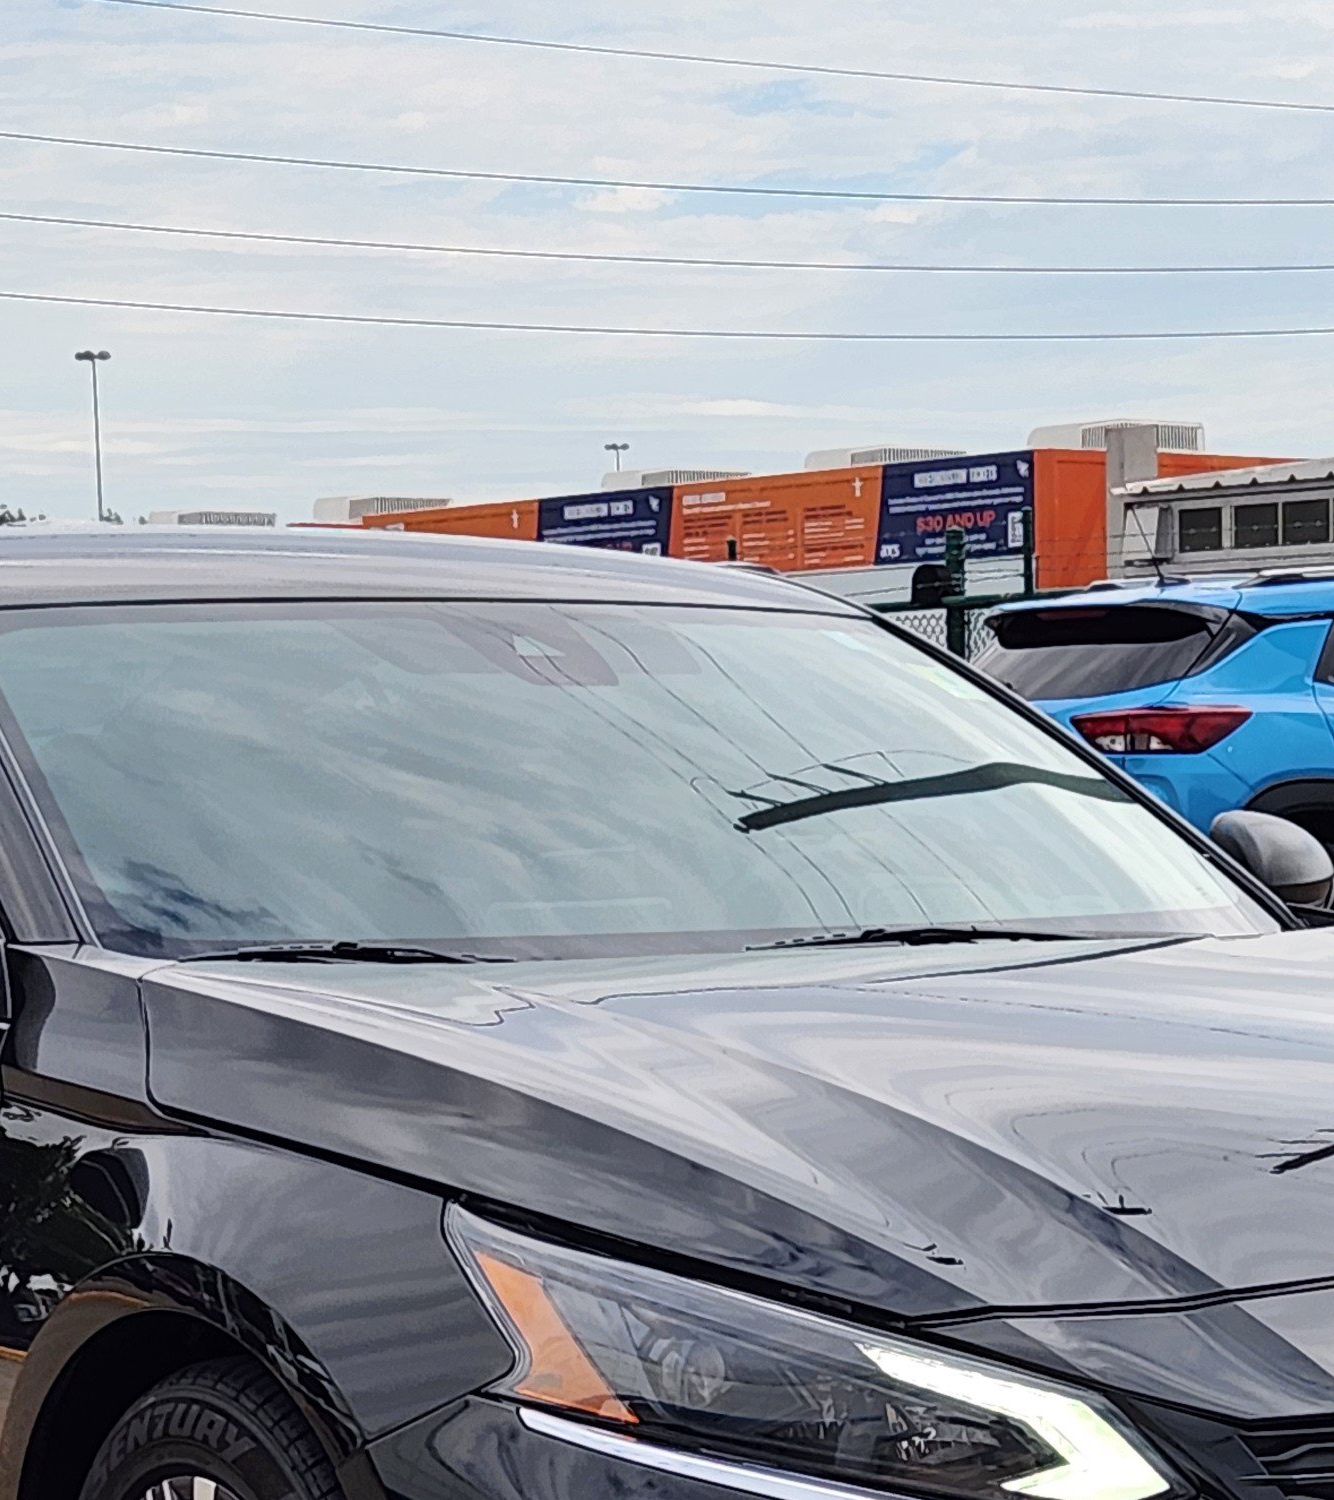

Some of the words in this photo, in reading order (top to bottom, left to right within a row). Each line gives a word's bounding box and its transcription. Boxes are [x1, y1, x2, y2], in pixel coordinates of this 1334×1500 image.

[916, 516, 943, 536] $30
[945, 513, 975, 528] AND
[976, 510, 996, 528] UP
